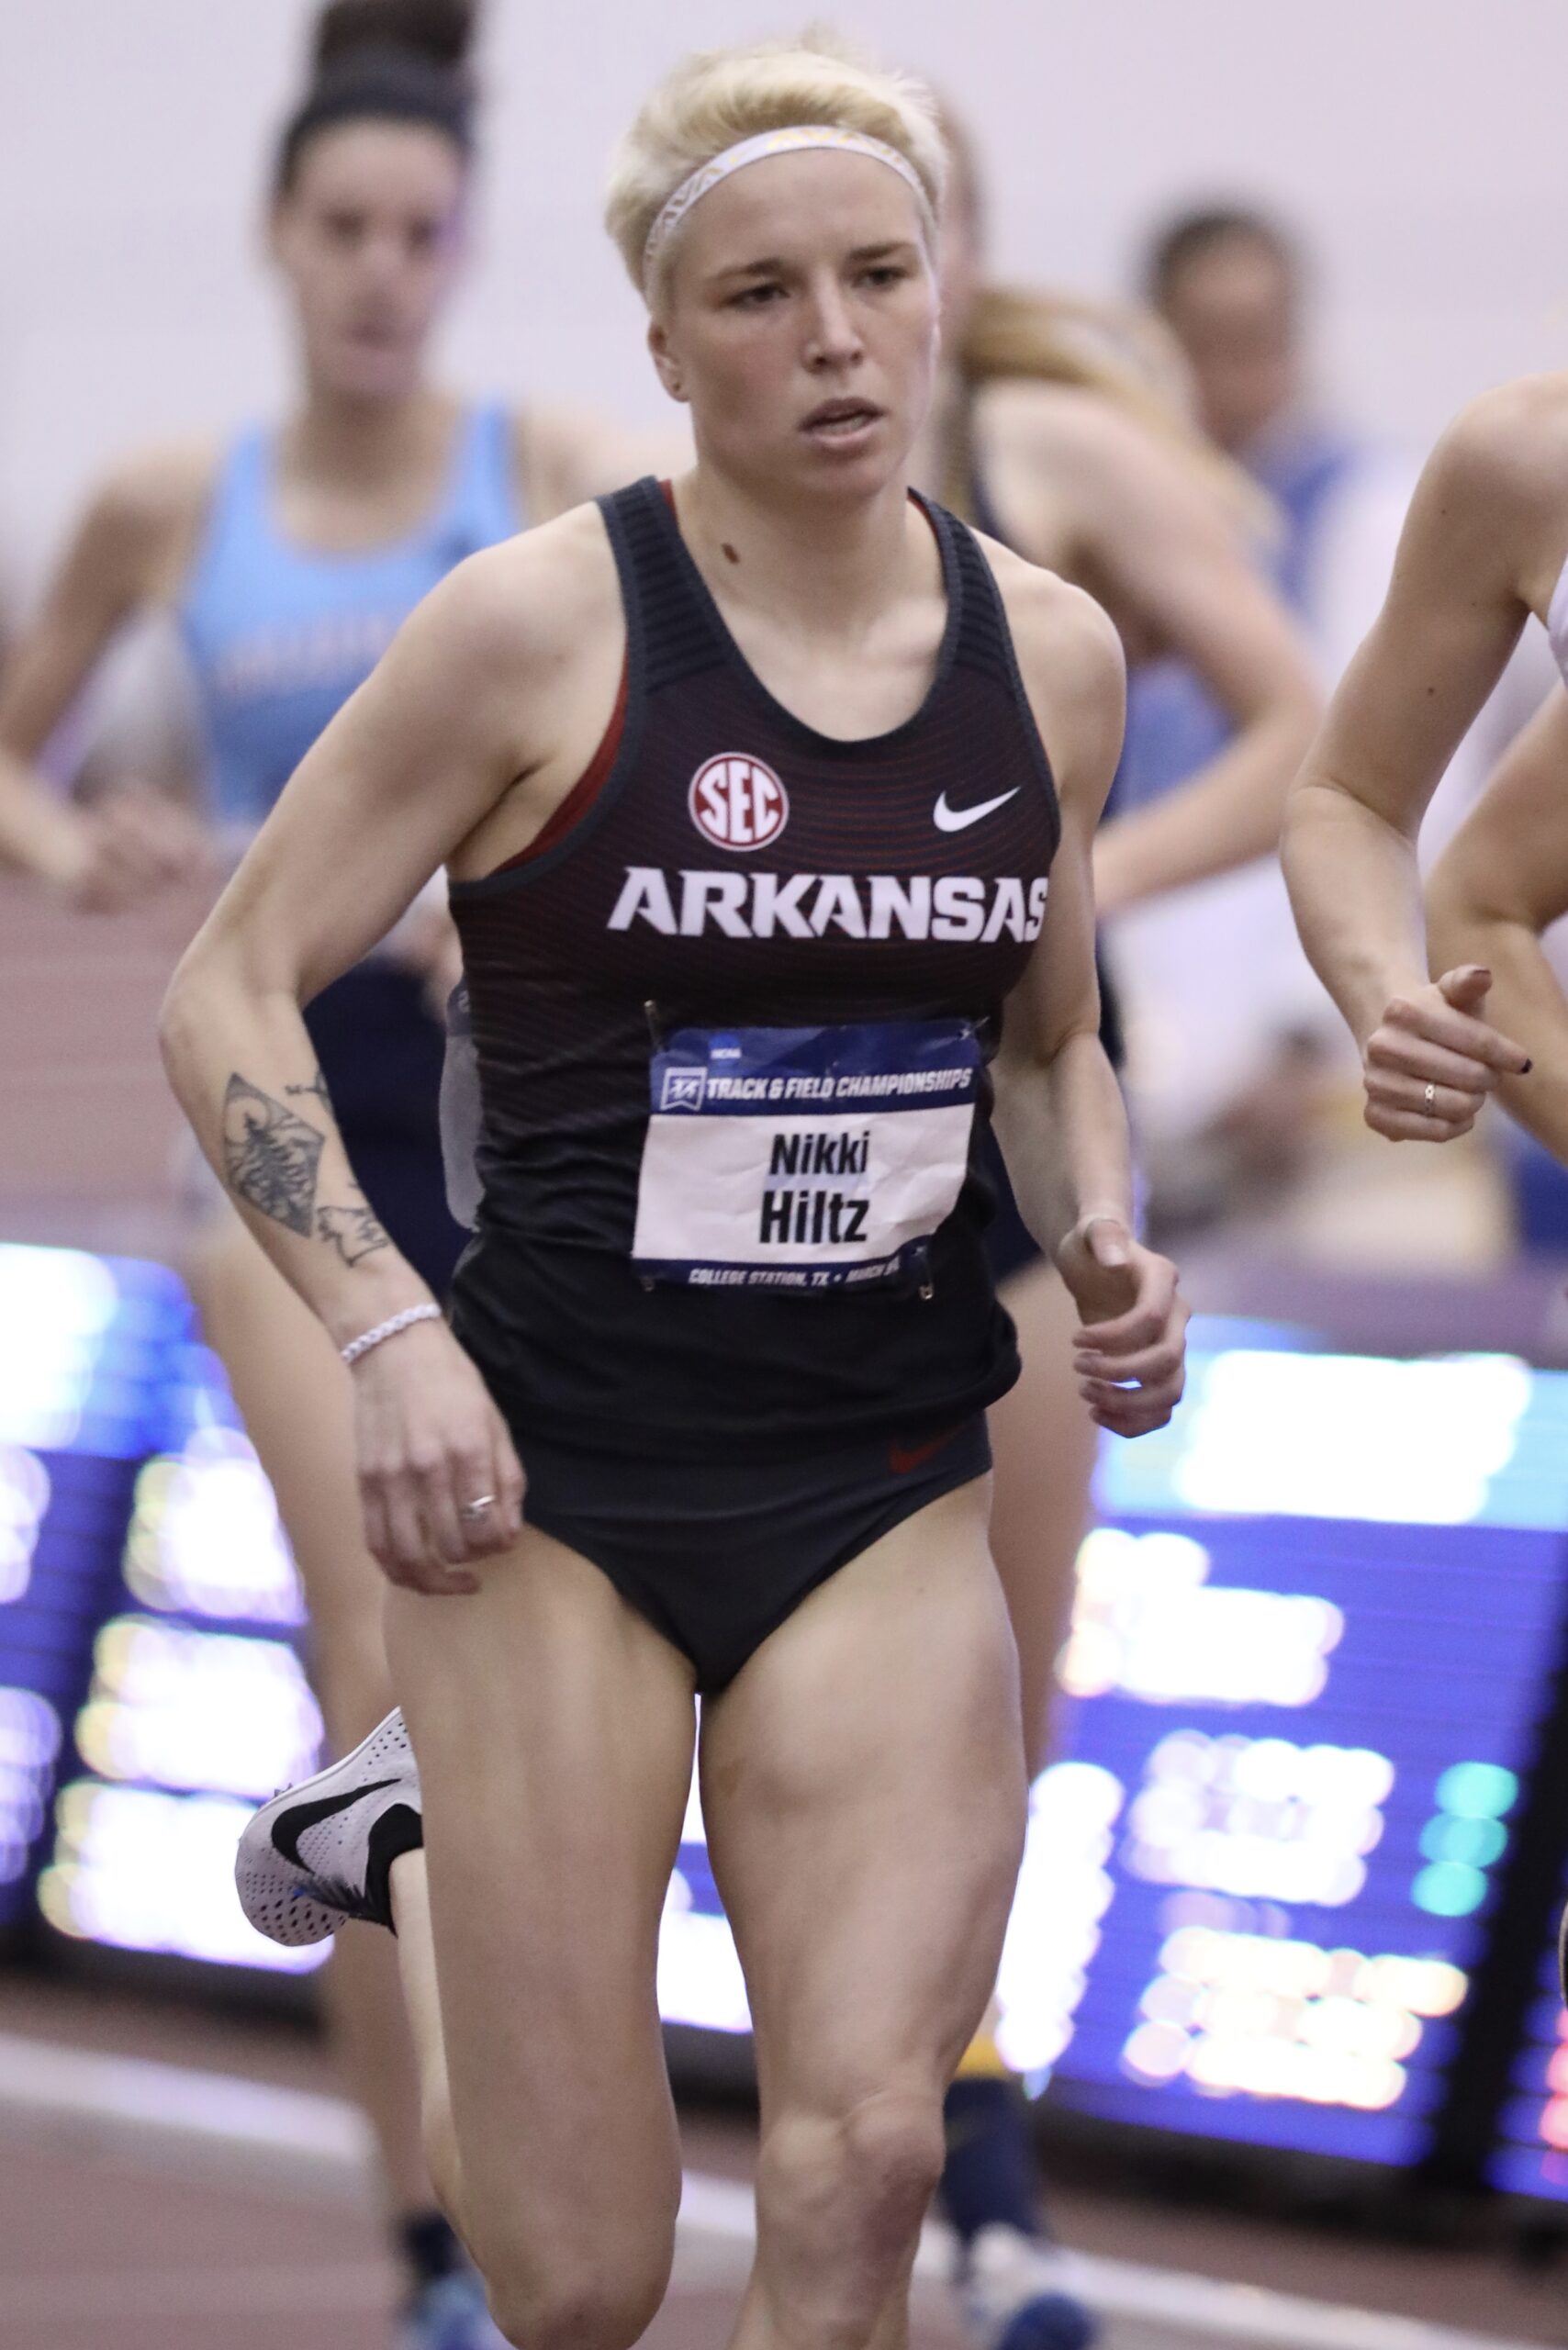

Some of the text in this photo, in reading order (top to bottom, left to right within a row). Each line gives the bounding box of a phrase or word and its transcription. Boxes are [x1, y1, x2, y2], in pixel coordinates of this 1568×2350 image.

[697, 761, 780, 844] SEC
[607, 866, 1048, 944] ARKANSAS
[706, 1068, 973, 1100] TRACK & FIELD CHAMPIONSHIPS
[769, 1130, 870, 1176] Nikki
[759, 1190, 870, 1244] Hiltz
[689, 1268, 749, 1285] COLLEGE
[811, 1270, 832, 1287] TX
